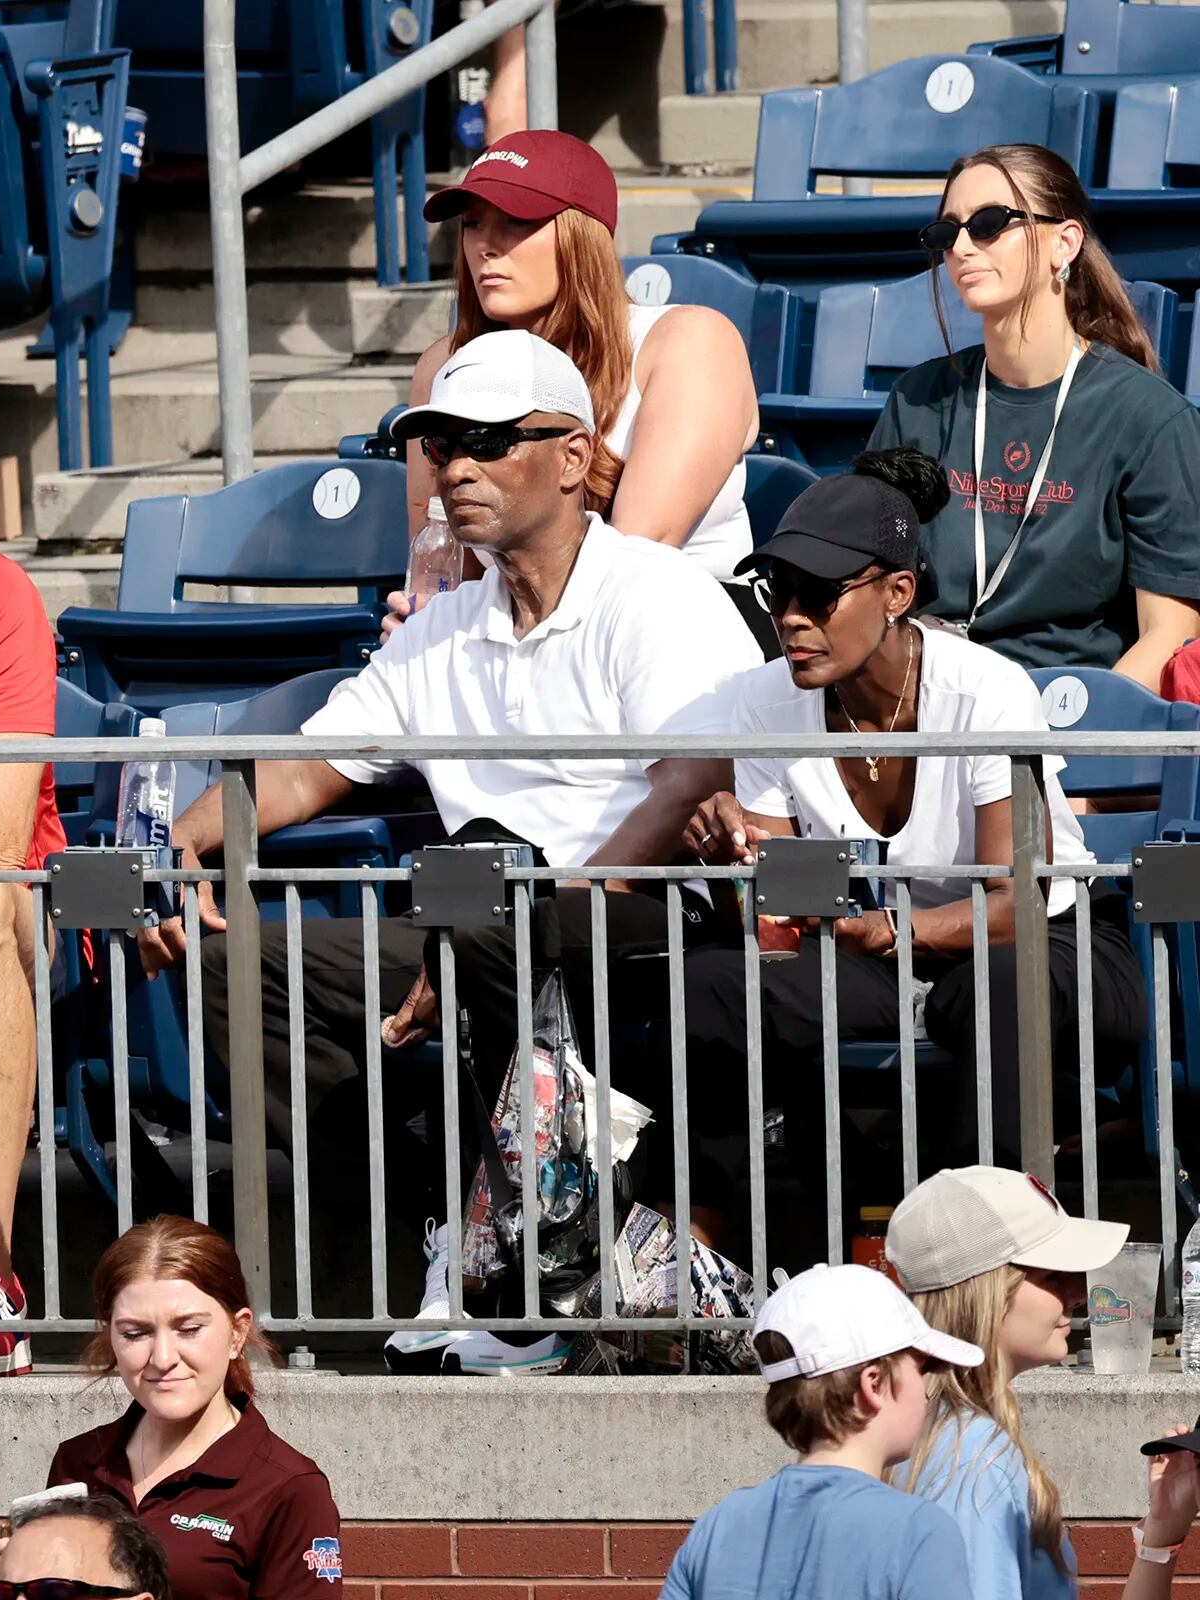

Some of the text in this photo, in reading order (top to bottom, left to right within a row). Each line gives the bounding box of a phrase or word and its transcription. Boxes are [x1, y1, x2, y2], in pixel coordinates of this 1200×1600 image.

[946, 79, 954, 97] 1
[644, 280, 651, 299] 1
[333, 485, 340, 503] 1
[1058, 692, 1068, 711] 4
[211, 1531, 230, 1542] CLUB
